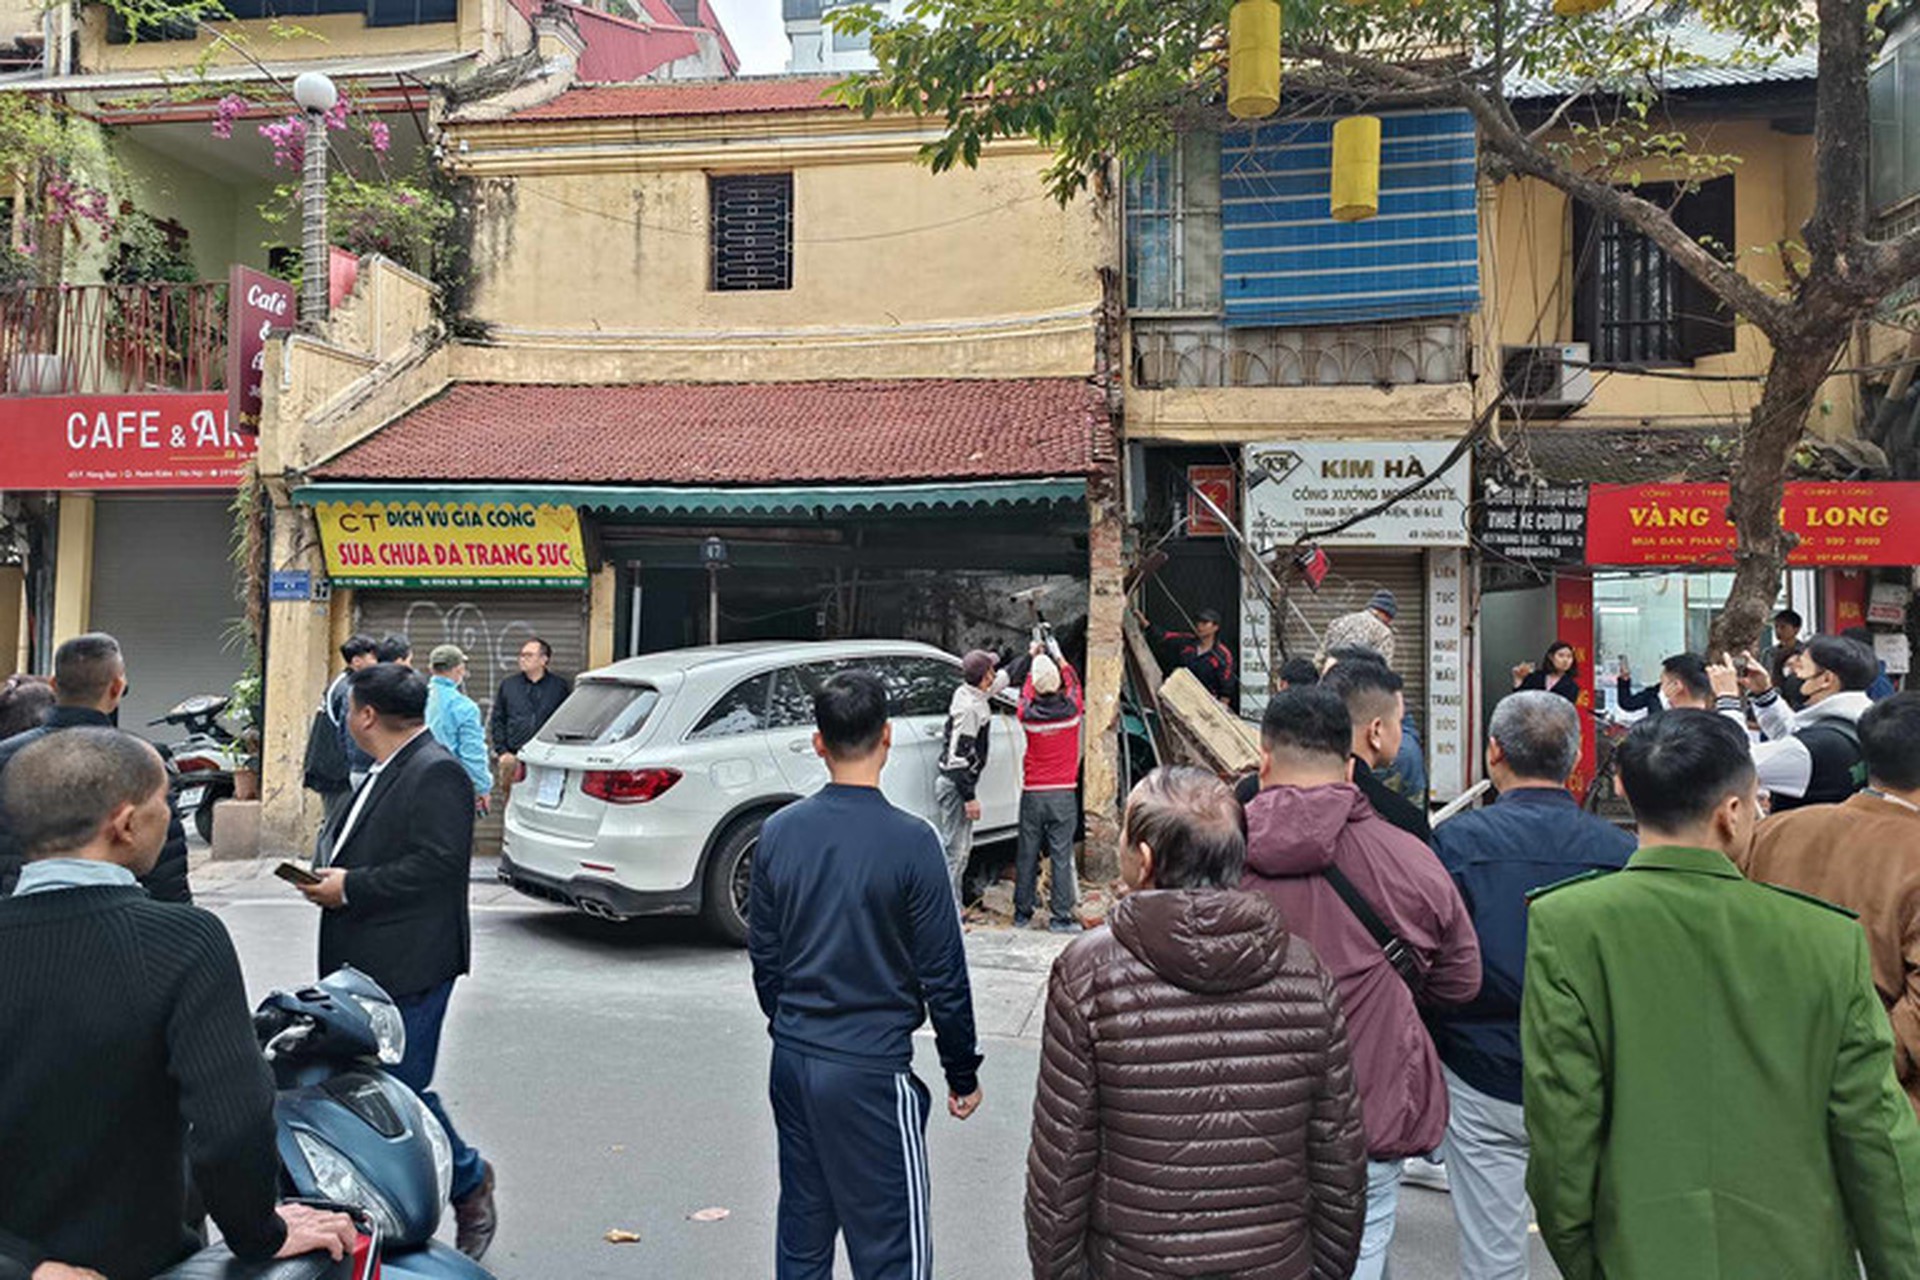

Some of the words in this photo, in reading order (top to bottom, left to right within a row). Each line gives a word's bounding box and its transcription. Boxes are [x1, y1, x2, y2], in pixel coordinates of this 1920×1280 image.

[67, 410, 161, 449] CAFE
[169, 424, 186, 448] &
[1321, 459, 1374, 479] KIM
[1384, 454, 1426, 479] HÀ
[339, 513, 380, 533] CT
[451, 510, 483, 528] GIA
[1565, 513, 1583, 530] VIP
[1629, 501, 1710, 527] VÀNG
[1805, 506, 1889, 527] LONG
[464, 543, 533, 566] TRANG
